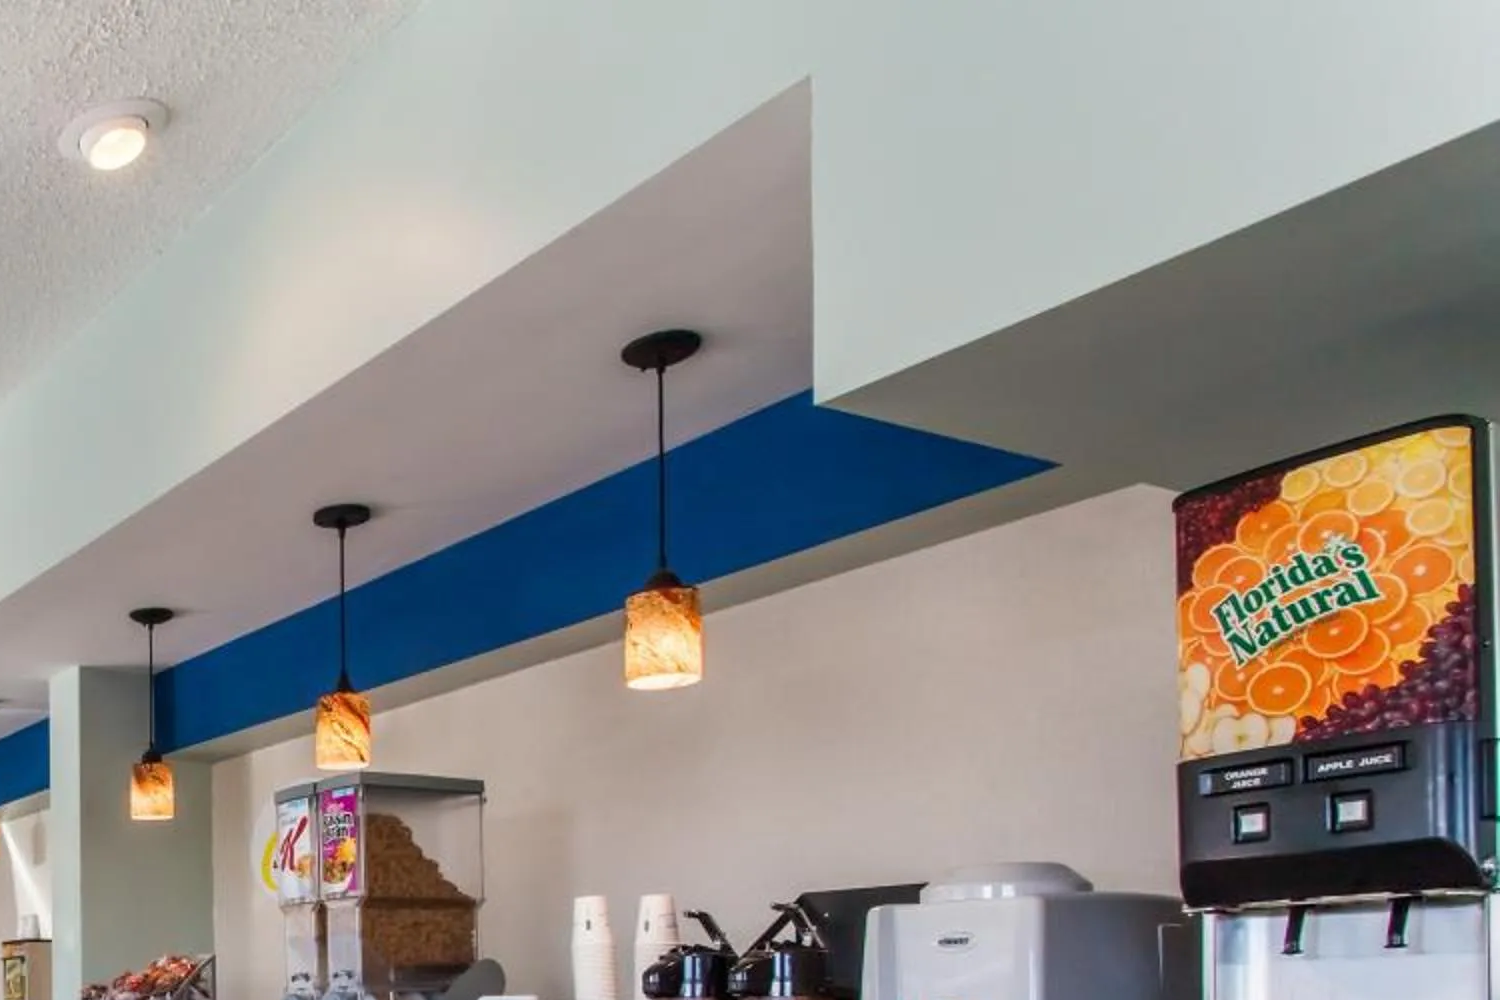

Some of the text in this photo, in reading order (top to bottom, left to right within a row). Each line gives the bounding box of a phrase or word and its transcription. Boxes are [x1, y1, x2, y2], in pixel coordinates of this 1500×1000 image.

[1211, 544, 1367, 635] Florida's
[1226, 568, 1381, 667] Natural
[1224, 766, 1269, 781] ORANGE
[1317, 752, 1393, 773] APPLE JUICE
[1231, 777, 1261, 789] JUICE
[279, 815, 308, 873] K
